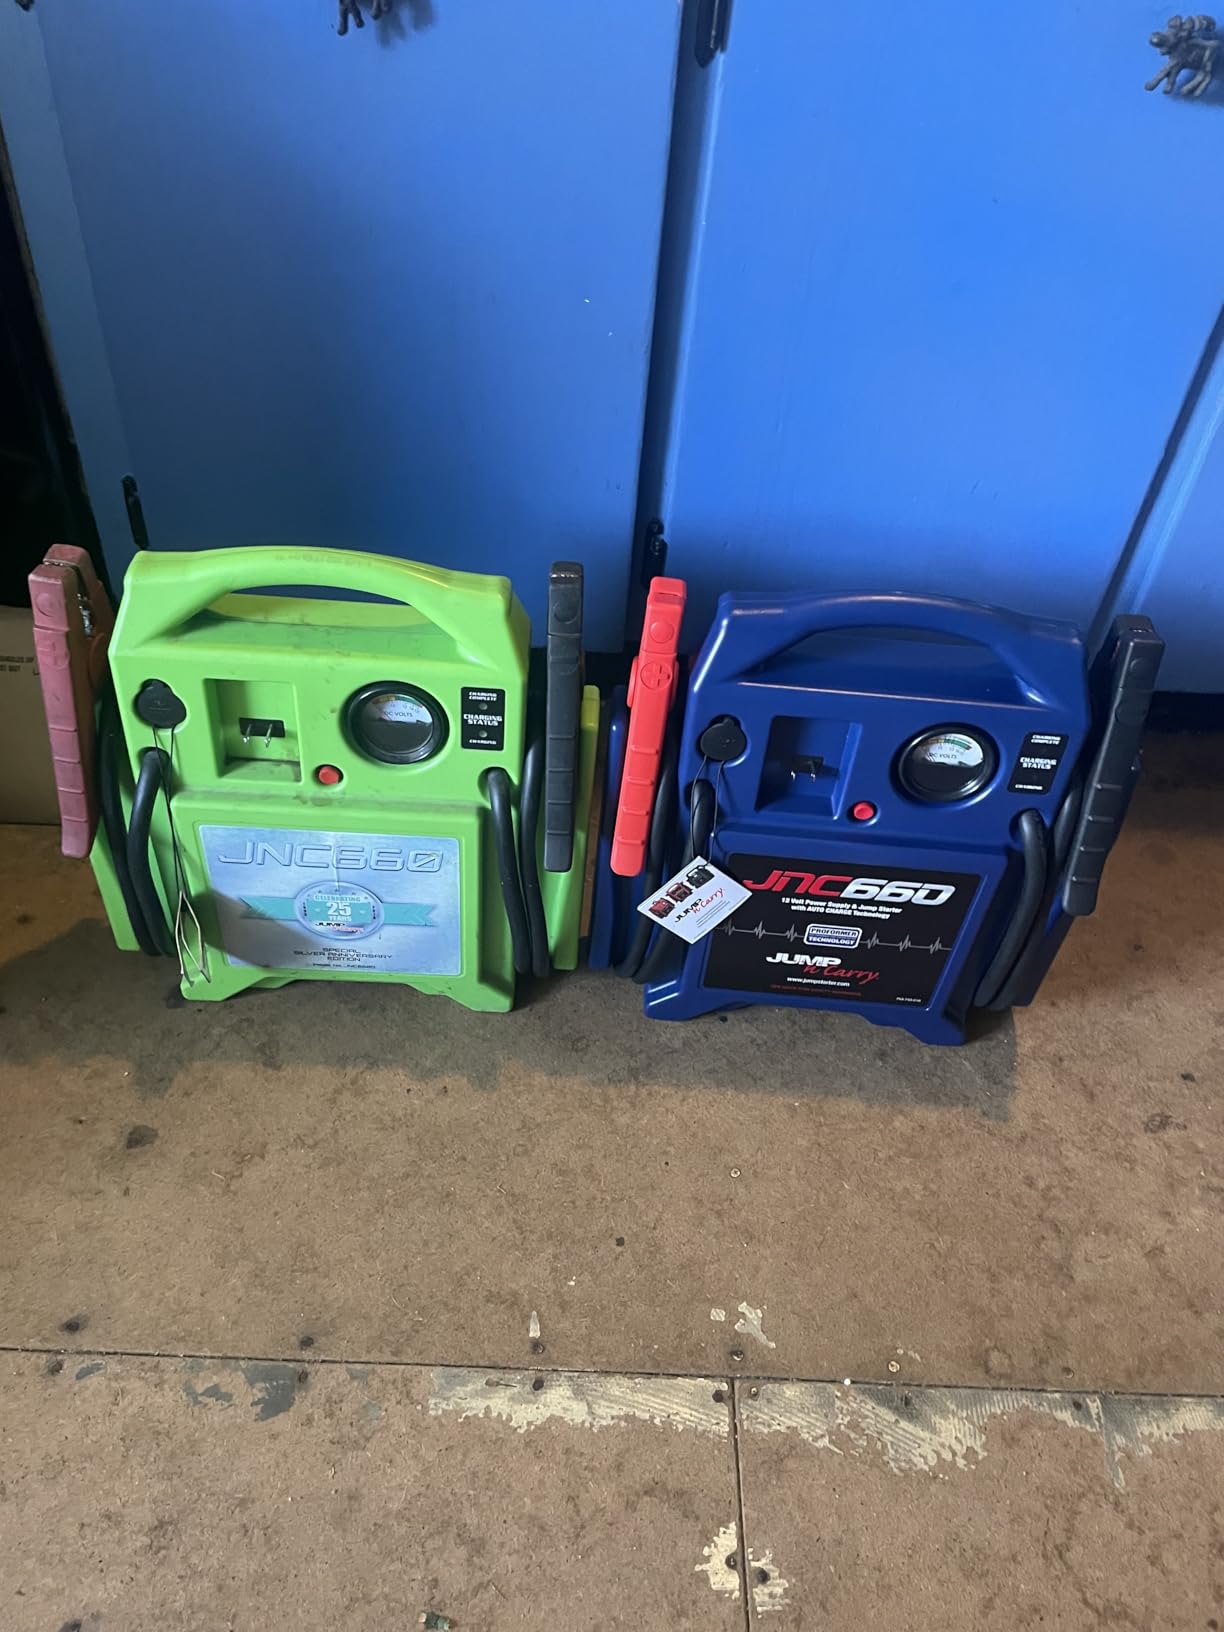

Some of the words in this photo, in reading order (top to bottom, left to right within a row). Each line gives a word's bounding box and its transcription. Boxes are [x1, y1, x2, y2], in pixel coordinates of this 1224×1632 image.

[463, 713, 503, 722] CHARGING
[467, 719, 499, 727] STATUS
[1020, 756, 1057, 766] CHARGING
[1022, 762, 1052, 770] STATUS
[218, 841, 444, 873] JNC660
[742, 870, 956, 906] JNC660
[700, 887, 725, 909] Carry
[790, 897, 805, 905] Volt
[804, 898, 828, 907] Power
[827, 900, 851, 911] Supply
[857, 903, 878, 912] Jump
[878, 905, 903, 914] Starter
[326, 901, 352, 917] 25
[674, 898, 703, 924] JUMP
[790, 904, 807, 912] with
[806, 905, 826, 913] AUTO
[824, 907, 853, 916] CHARGE
[852, 909, 891, 920] Technology
[808, 935, 856, 946] TECHNOLOGY
[810, 927, 858, 938] PROFORMER
[327, 951, 393, 959] ANNIVERSARY
[765, 952, 842, 968] JUMP
[786, 976, 851, 988] www.jumpstarter.com
[823, 966, 880, 985] Carry
